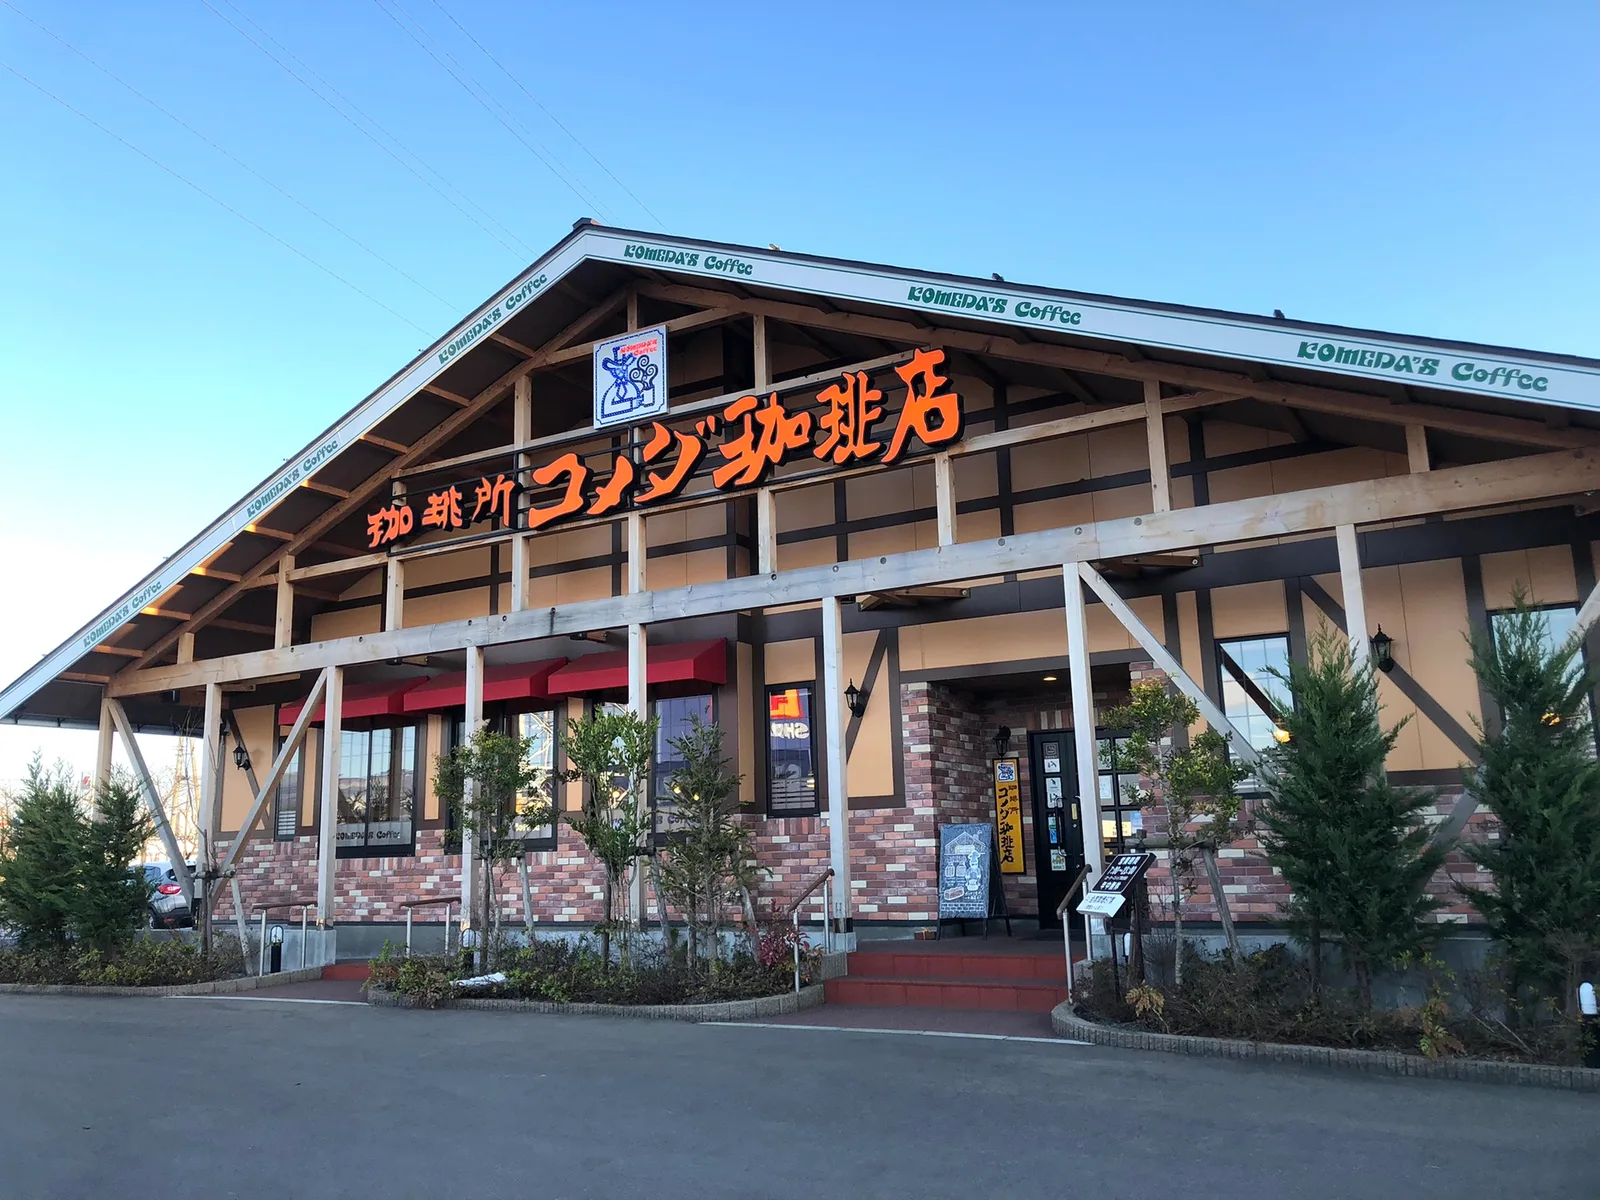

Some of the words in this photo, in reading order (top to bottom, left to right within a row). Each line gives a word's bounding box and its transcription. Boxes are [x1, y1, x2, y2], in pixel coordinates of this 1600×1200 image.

[624, 245, 699, 267] KOMEDA'S
[703, 256, 753, 276] Coffee
[907, 286, 1009, 315] KOMEDA'S
[1014, 300, 1082, 326] Coffee
[1297, 341, 1440, 376] KOMEDA'S
[1451, 362, 1548, 392] Coffee
[366, 474, 516, 549] 珈琲所
